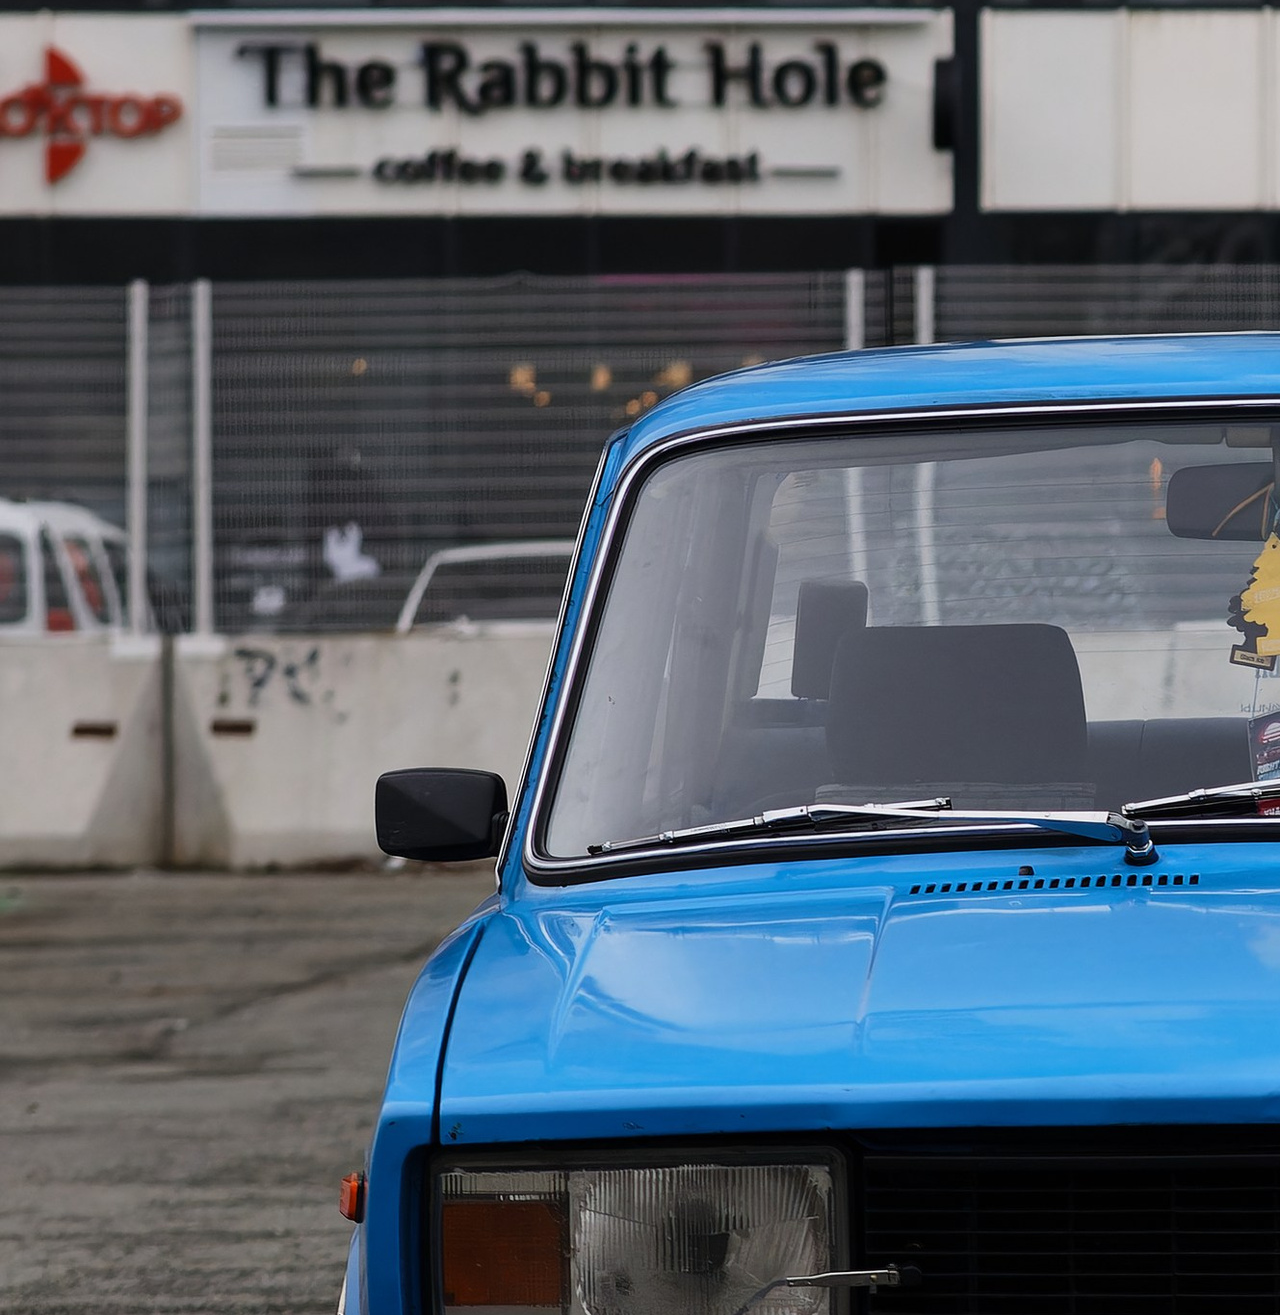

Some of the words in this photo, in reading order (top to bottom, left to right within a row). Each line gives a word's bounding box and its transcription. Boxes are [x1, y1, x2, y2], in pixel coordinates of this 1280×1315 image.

[237, 41, 395, 109] The
[420, 41, 677, 116] Rabbit
[706, 41, 886, 109] Hole
[372, 148, 505, 183] coffee
[521, 149, 547, 183] &
[563, 147, 761, 182] breakfast
